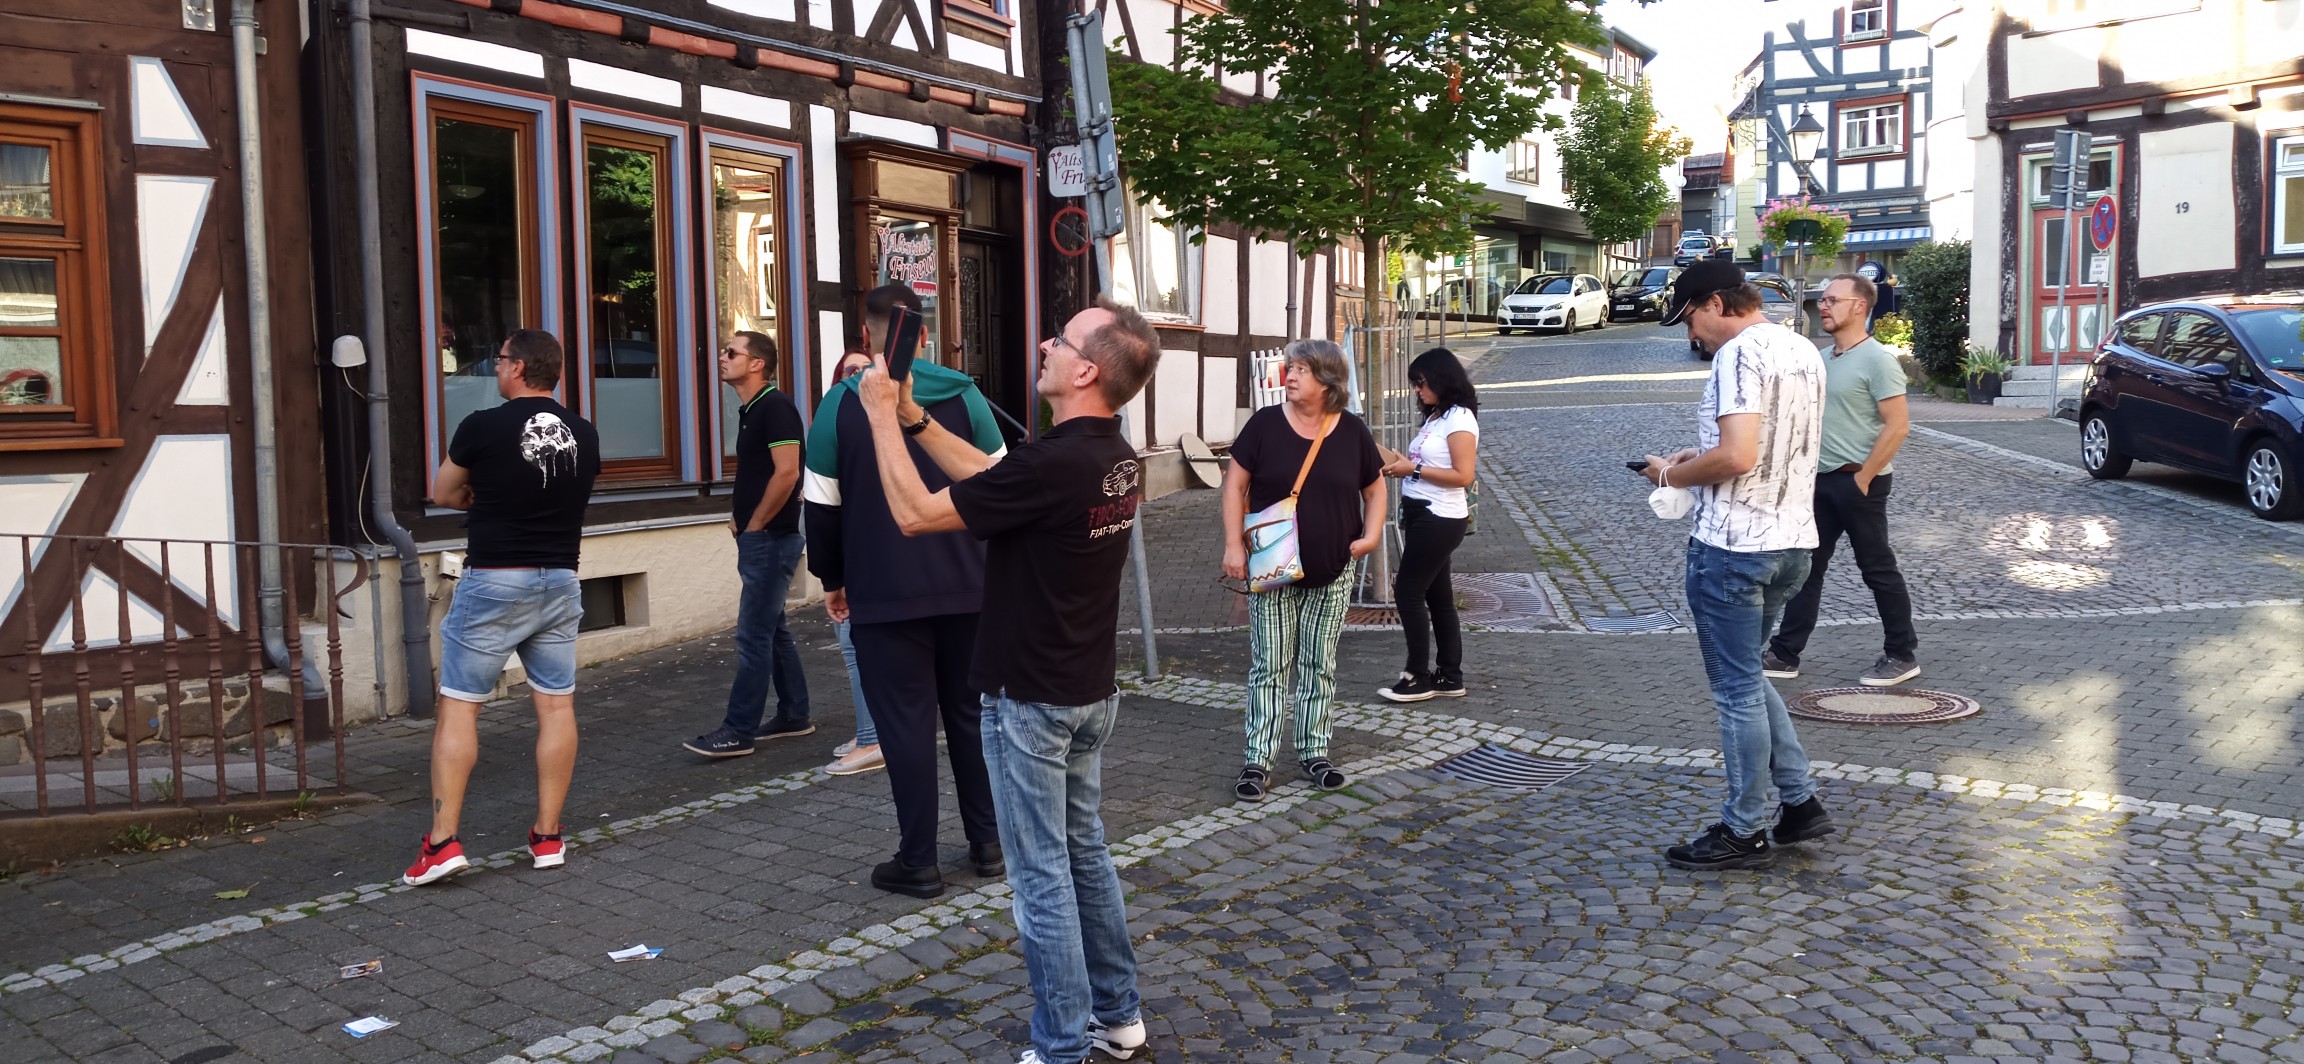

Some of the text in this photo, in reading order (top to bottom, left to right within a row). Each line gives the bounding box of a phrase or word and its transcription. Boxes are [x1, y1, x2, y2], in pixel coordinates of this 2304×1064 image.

[1058, 152, 1082, 169] Alts
[1061, 168, 1085, 185] Fri
[2175, 201, 2189, 214] 19
[886, 232, 931, 256] Altstadt
[889, 250, 936, 281] Friseur
